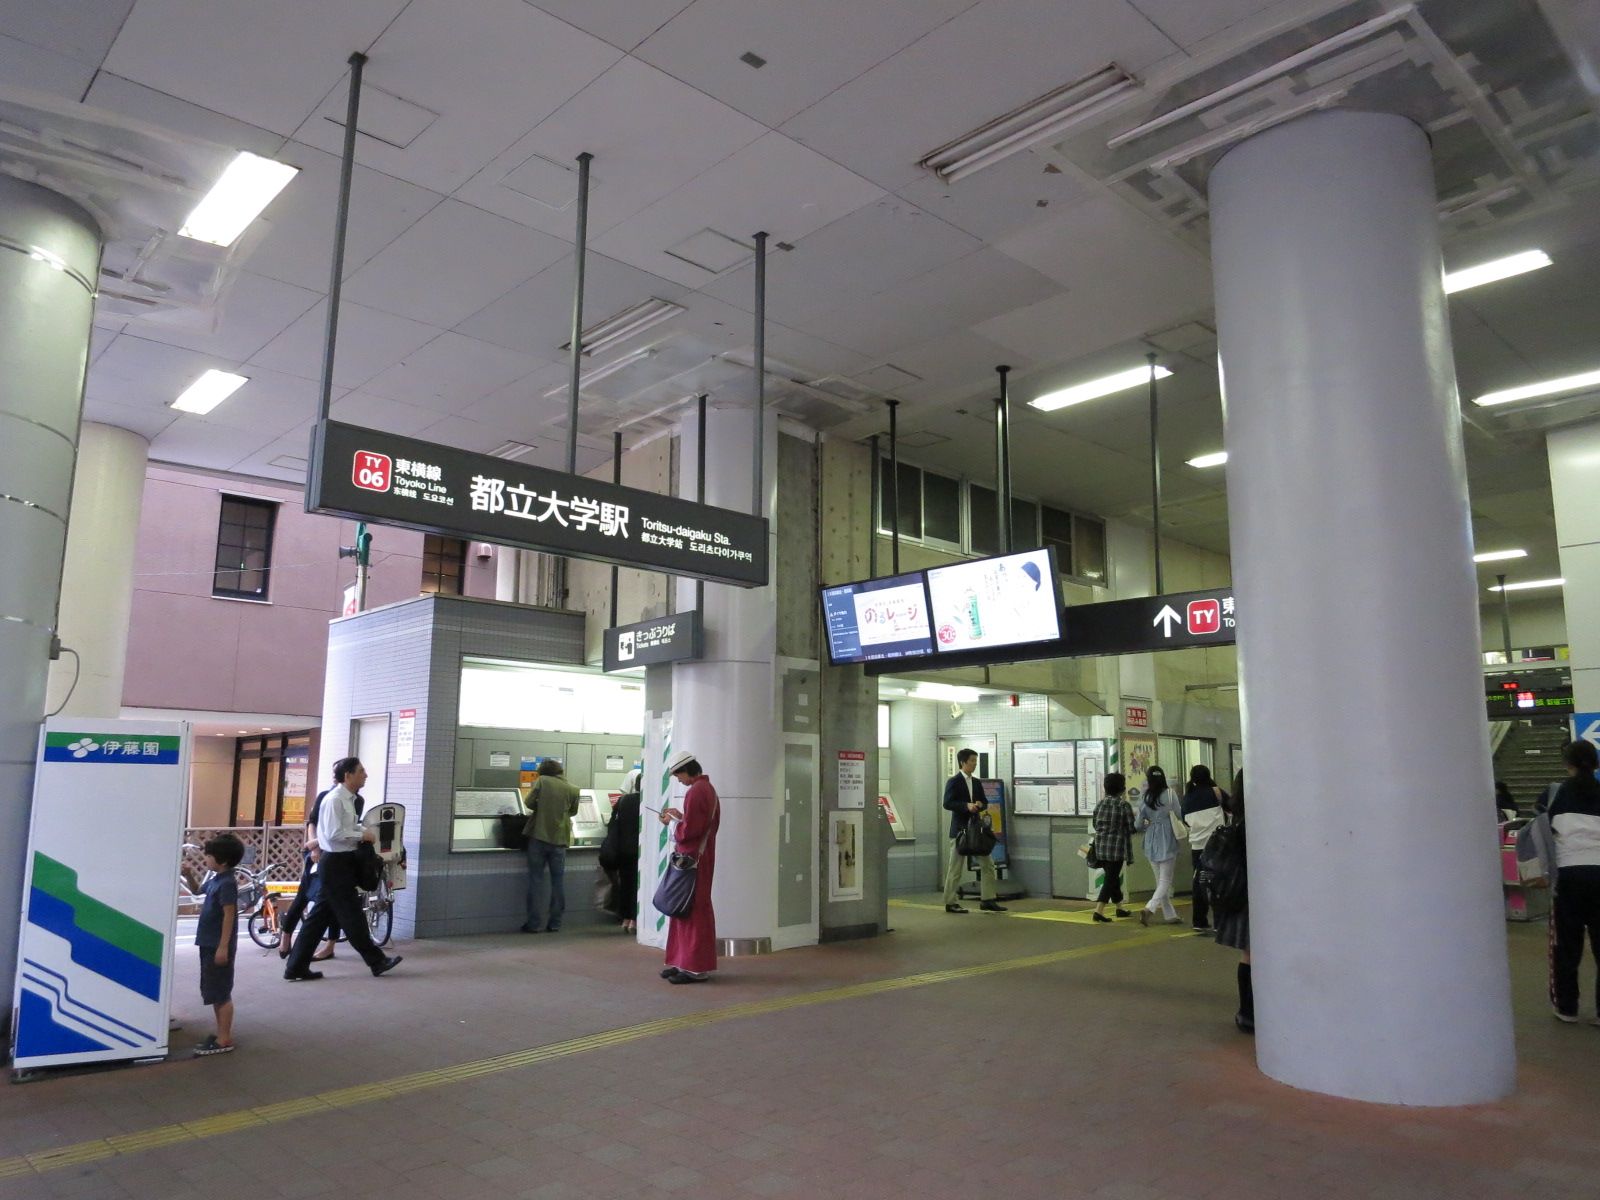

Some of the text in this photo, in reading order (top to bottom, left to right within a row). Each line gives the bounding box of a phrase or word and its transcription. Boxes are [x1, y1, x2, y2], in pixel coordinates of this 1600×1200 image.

[365, 455, 382, 469] TY
[395, 458, 442, 482] 東横線
[359, 468, 384, 488] 06
[394, 475, 448, 494] Toyoko Line
[469, 475, 630, 539] 都立大学駅
[640, 516, 732, 546] Toritsu-daigaku Sta.
[641, 531, 684, 550] 都立大学站
[689, 541, 752, 563] 도리츠다이가쿠역
[1193, 608, 1214, 625] TY
[101, 739, 160, 757] 伊藤園
